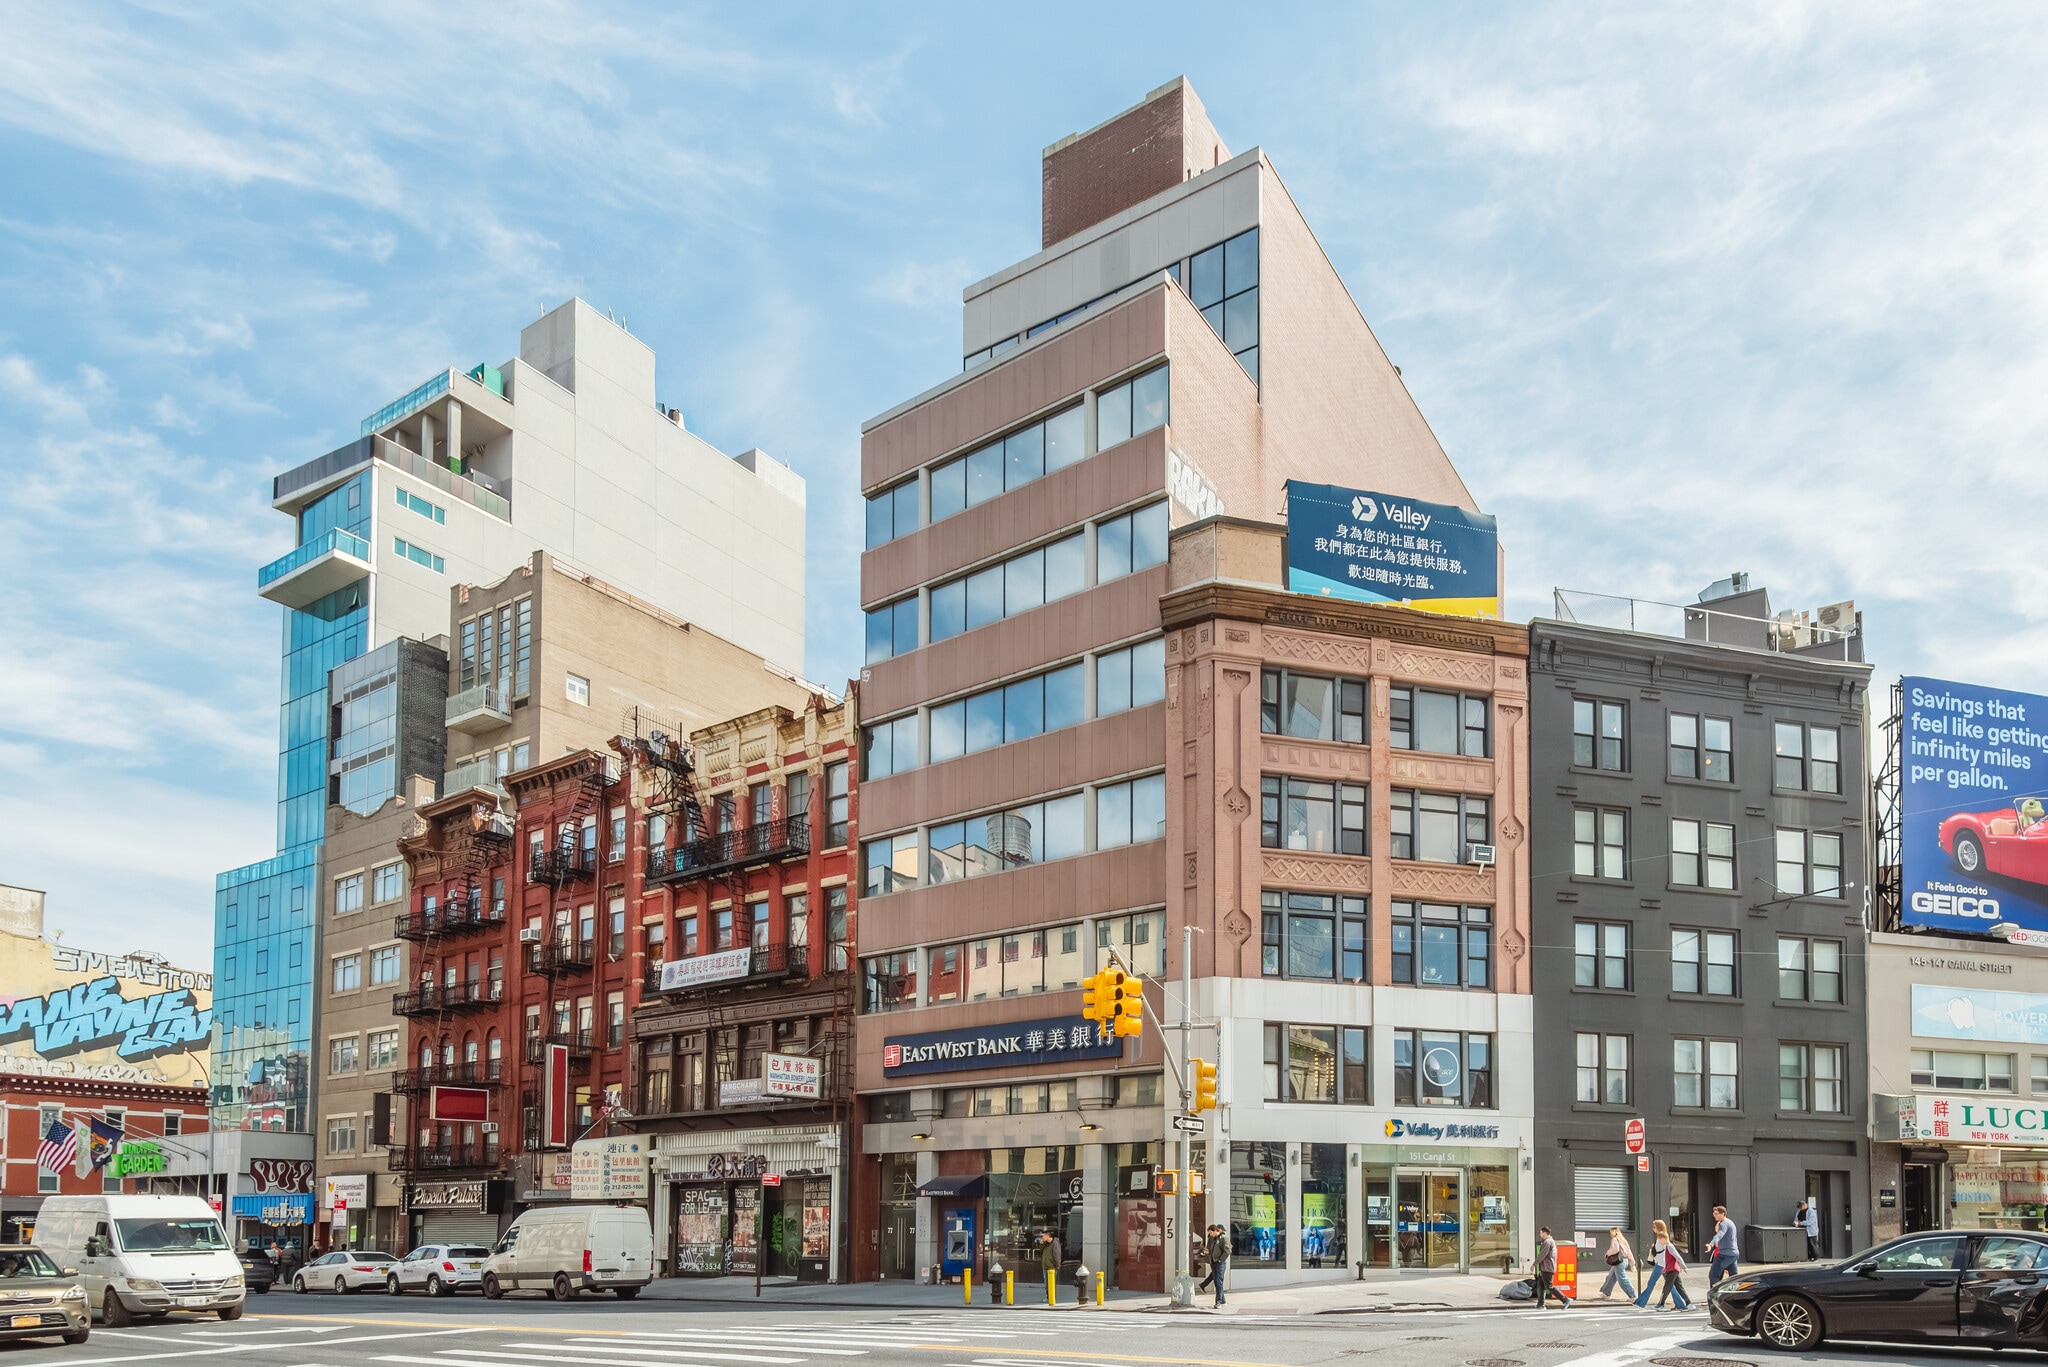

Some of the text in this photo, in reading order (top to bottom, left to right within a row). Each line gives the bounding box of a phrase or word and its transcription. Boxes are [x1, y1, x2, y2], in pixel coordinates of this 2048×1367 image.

[1382, 502, 1431, 531] Valley
[1348, 564, 1435, 590] 歡迎隨時光臨。
[1911, 687, 2026, 722] Savings that
[1911, 712, 1947, 735] feel
[1952, 717, 1984, 739] like
[1911, 736, 2031, 770] infinity miles
[1911, 765, 2009, 790] per gallon.
[1927, 881, 1988, 896] It Feels Good to
[1911, 891, 2000, 920] GEICO
[1910, 956, 2013, 974] 145-147 CANAL STREET
[977, 1037, 1022, 1056] BANK
[1024, 1025, 1115, 1053] 華美銀行
[772, 1058, 816, 1074] 包厘旅館
[770, 1072, 790, 1080] MANHATTAN
[1934, 1099, 1949, 1137] 祥龍
[1406, 1122, 1444, 1141] Valley
[1446, 1123, 1500, 1140] 萬利銀行
[1971, 1131, 2010, 1140] NEW YORK
[122, 1155, 163, 1174] GARDEN
[1191, 1149, 1206, 1165] 75
[1409, 1152, 1456, 1161] 151 Canal St
[1954, 1171, 1979, 1181] HAPPY
[1980, 1171, 2005, 1181] LUCKY
[411, 1186, 481, 1205] Phoenix Palace
[685, 1190, 717, 1203] SPAC
[1466, 1186, 1501, 1200] alley
[1953, 1192, 1992, 1203] BOSTON
[681, 1203, 697, 1214] FOR
[736, 1199, 744, 1207] FOR
[1406, 1204, 1419, 1213] Valley
